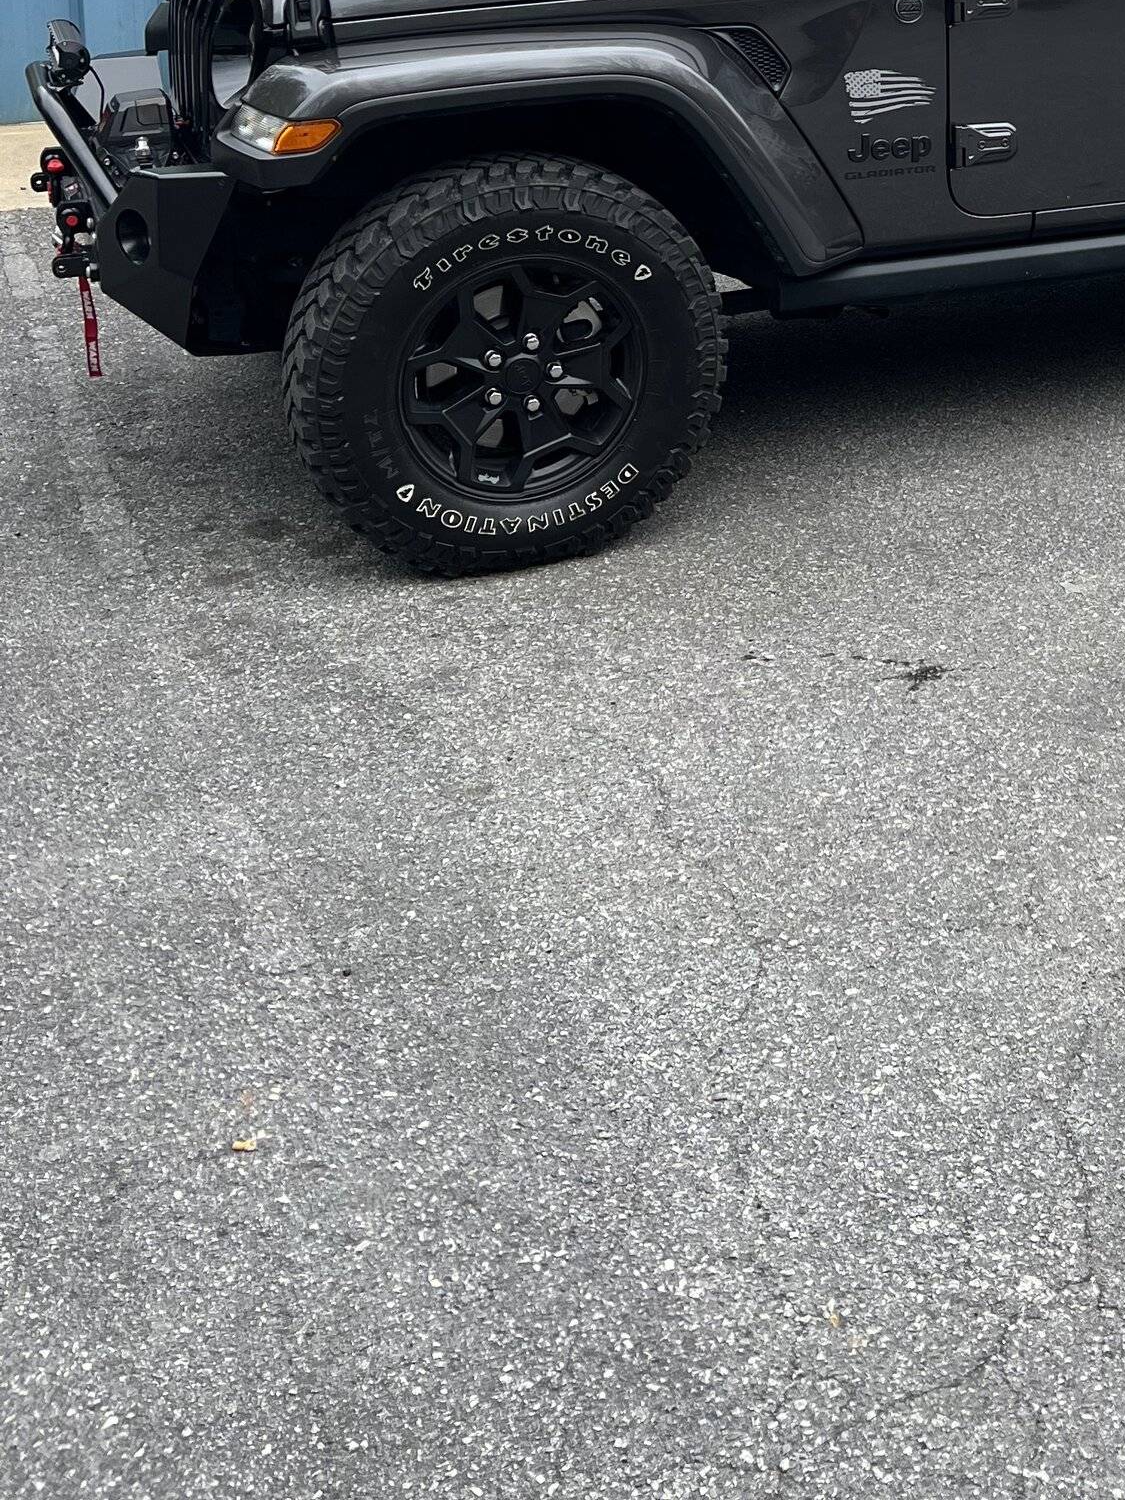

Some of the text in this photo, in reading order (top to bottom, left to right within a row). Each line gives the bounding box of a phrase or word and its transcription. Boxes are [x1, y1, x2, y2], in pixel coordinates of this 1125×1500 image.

[847, 132, 932, 163] Jeep
[844, 165, 937, 180] GLADIATOR
[413, 224, 632, 292] Firestone
[88, 340, 99, 373] WARN
[416, 462, 640, 536] DESTINATION
